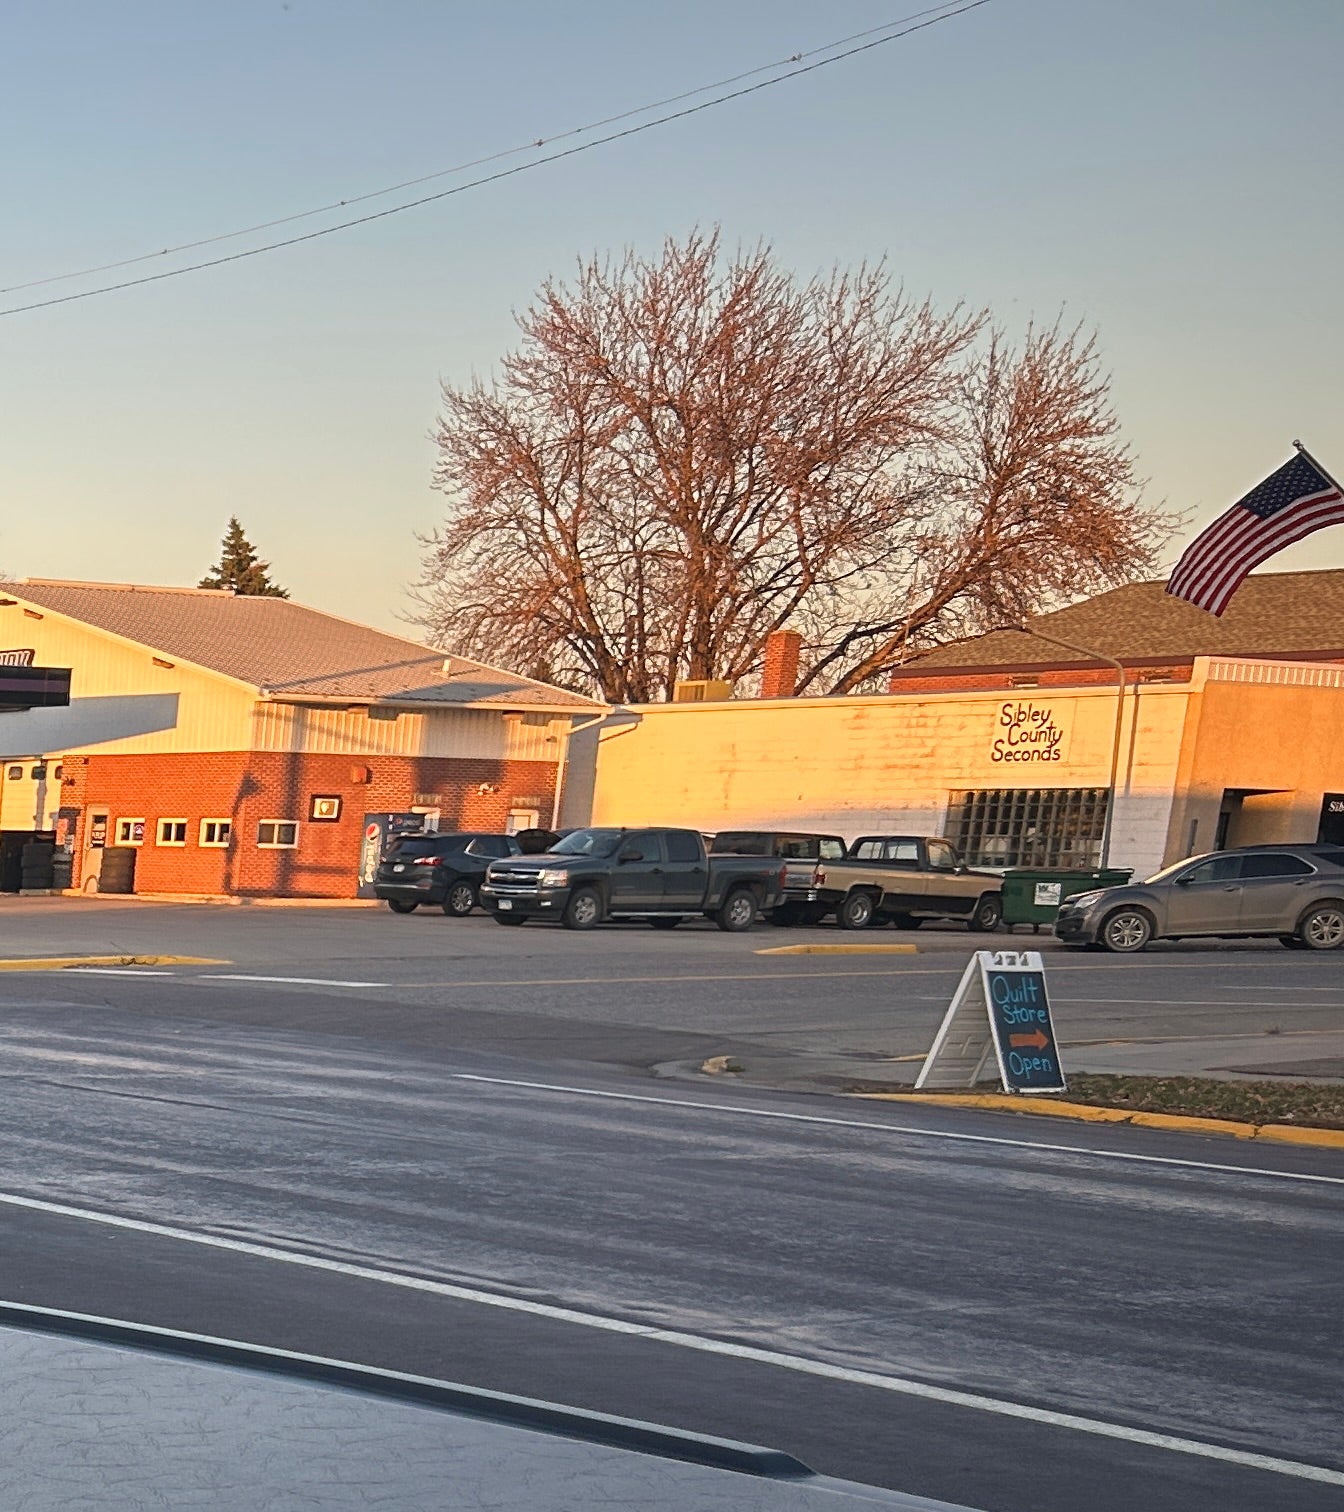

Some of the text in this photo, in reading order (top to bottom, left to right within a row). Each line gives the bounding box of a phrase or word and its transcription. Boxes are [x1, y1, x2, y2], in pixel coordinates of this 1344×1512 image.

[1000, 703, 1052, 729] Sibley
[1007, 721, 1064, 748] County
[991, 738, 1061, 762] Seconds
[992, 975, 1038, 1004] Quilt
[1002, 1004, 1048, 1024] Store
[1008, 1051, 1052, 1080] Open
